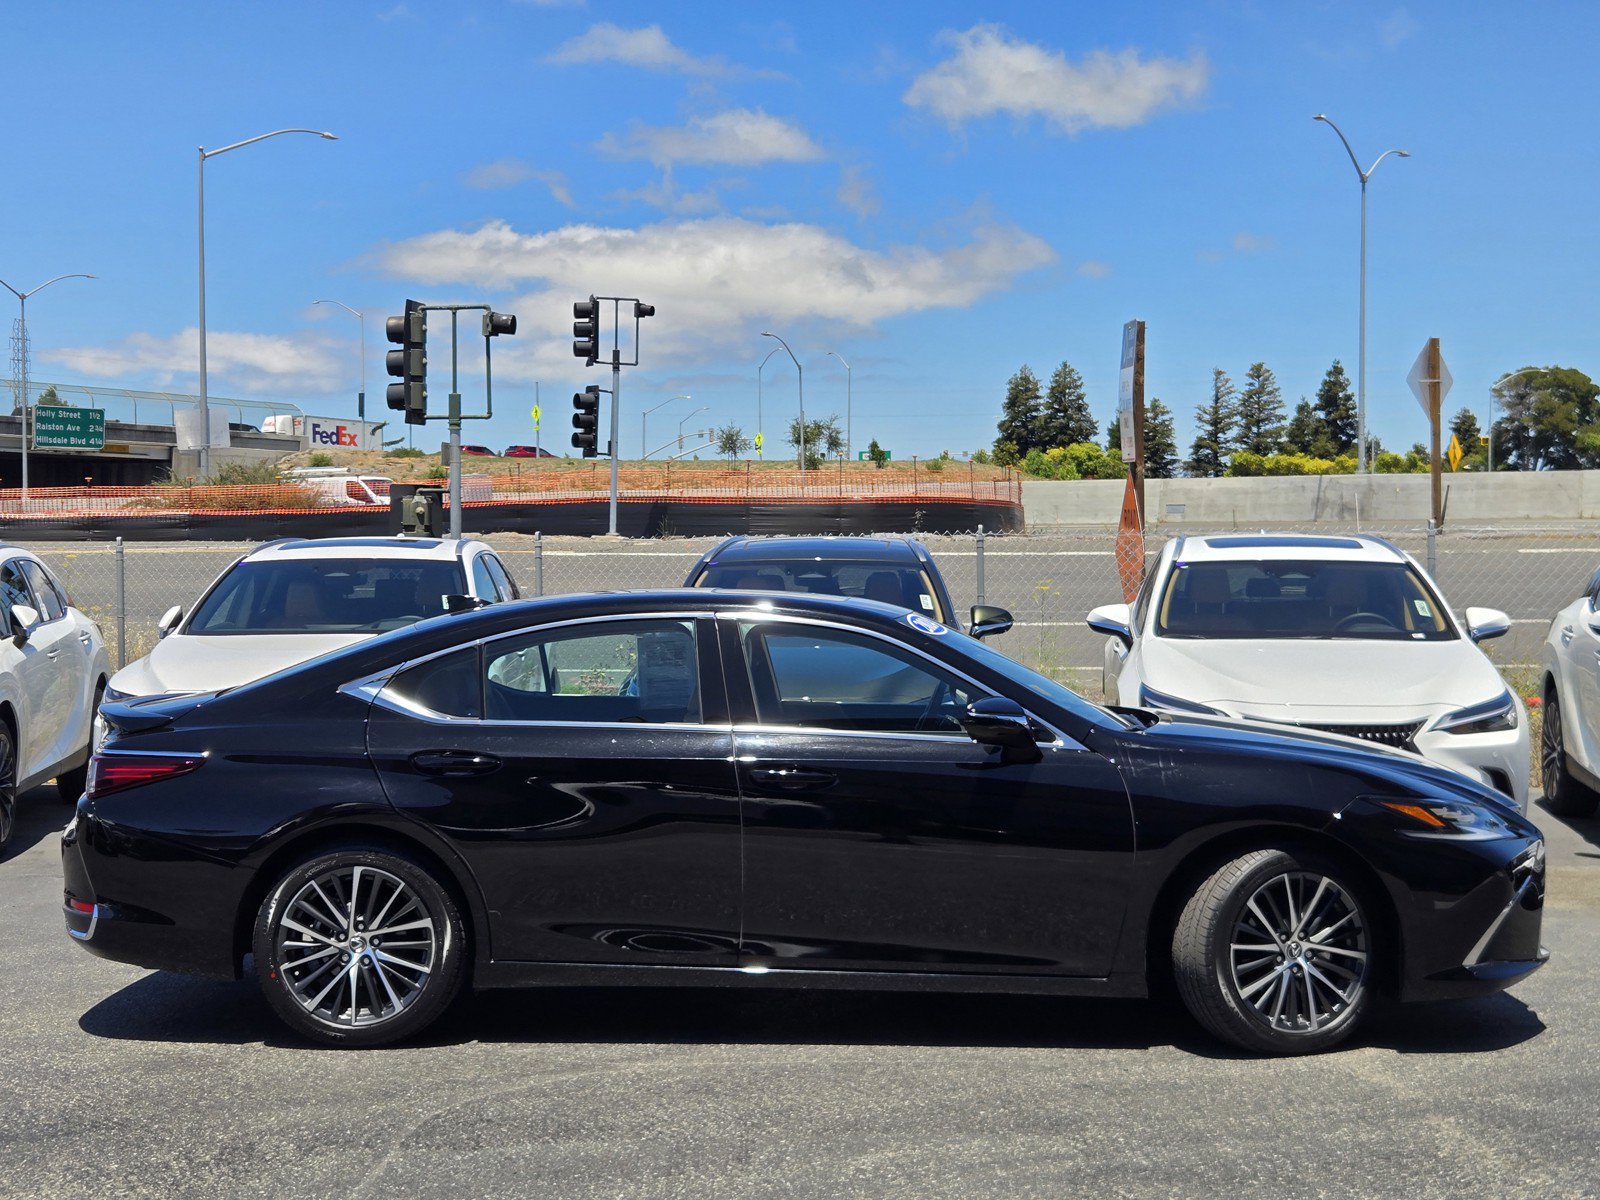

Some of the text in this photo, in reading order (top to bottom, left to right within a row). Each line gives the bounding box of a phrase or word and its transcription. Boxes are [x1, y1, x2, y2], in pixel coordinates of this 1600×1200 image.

[36, 409, 55, 419] Holly
[58, 410, 81, 419] Street
[36, 423, 64, 431] Ralston
[312, 423, 358, 447] FedEx
[36, 436, 67, 444] Hillsdale
[70, 437, 86, 445] Blvd
